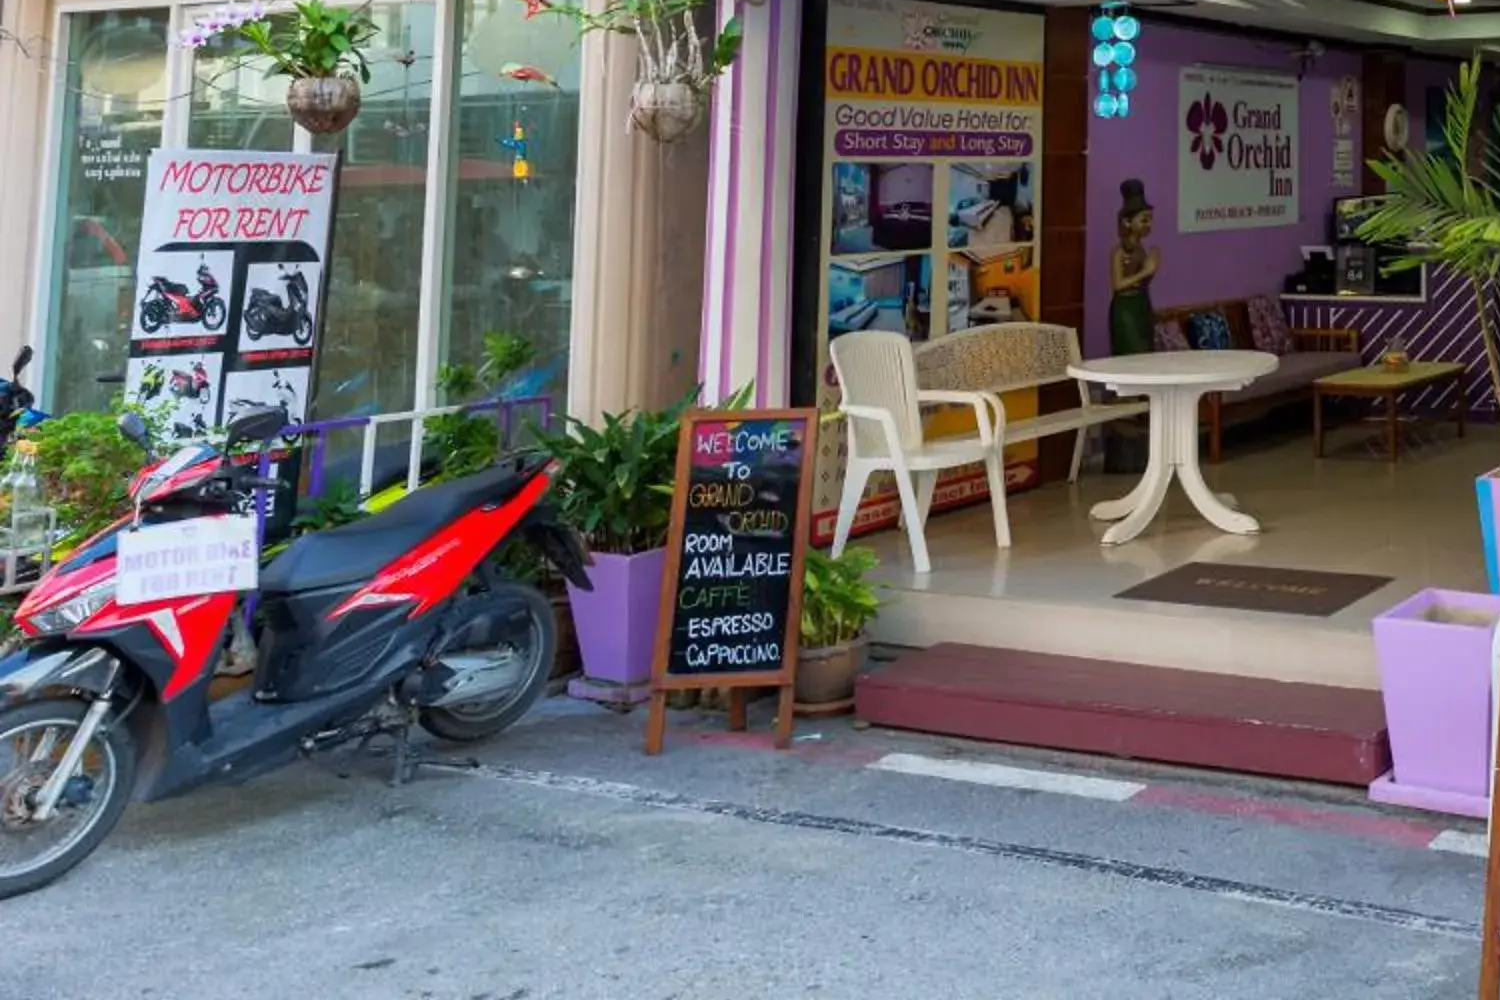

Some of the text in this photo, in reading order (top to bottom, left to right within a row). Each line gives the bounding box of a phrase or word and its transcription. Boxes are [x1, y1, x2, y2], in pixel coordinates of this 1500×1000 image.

[830, 53, 1040, 103] GRAND ORCHID INN
[835, 104, 898, 128] Good
[900, 107, 954, 130] Value
[957, 109, 1004, 130] Hotel
[1233, 101, 1281, 130] Grand
[844, 131, 1026, 156] Short Stay and Long Stay
[1227, 133, 1291, 170] Orchid
[159, 161, 329, 195] MOTORBIKE
[1269, 170, 1293, 198] Inn
[173, 207, 310, 240] FOR RENT
[697, 429, 791, 454] WELCOME
[721, 461, 751, 481] TO
[689, 482, 755, 508] GRAND
[123, 539, 252, 572] MOTOR BIKE
[685, 533, 734, 554] ROOM
[685, 553, 791, 579] AVAILABLE
[688, 612, 774, 639] ESPRESSO
